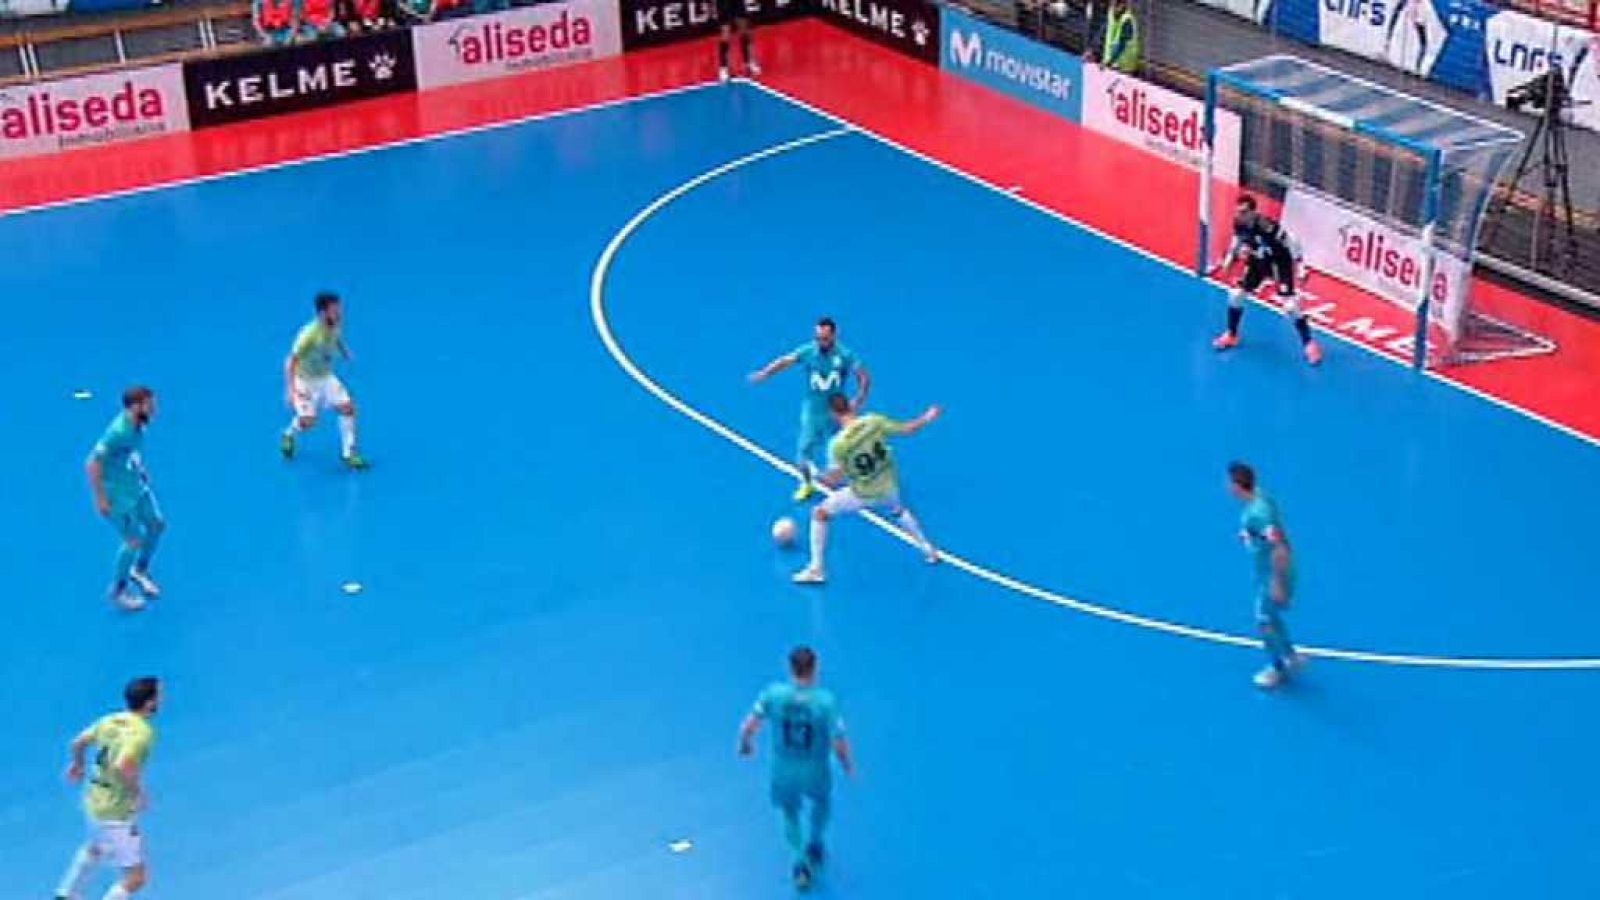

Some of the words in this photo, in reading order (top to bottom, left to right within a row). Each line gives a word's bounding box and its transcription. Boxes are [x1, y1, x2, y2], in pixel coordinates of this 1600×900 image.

[461, 9, 592, 65] aliseda
[206, 59, 358, 110] KELME
[985, 48, 1072, 101] movistar
[1, 80, 164, 140] aliseda
